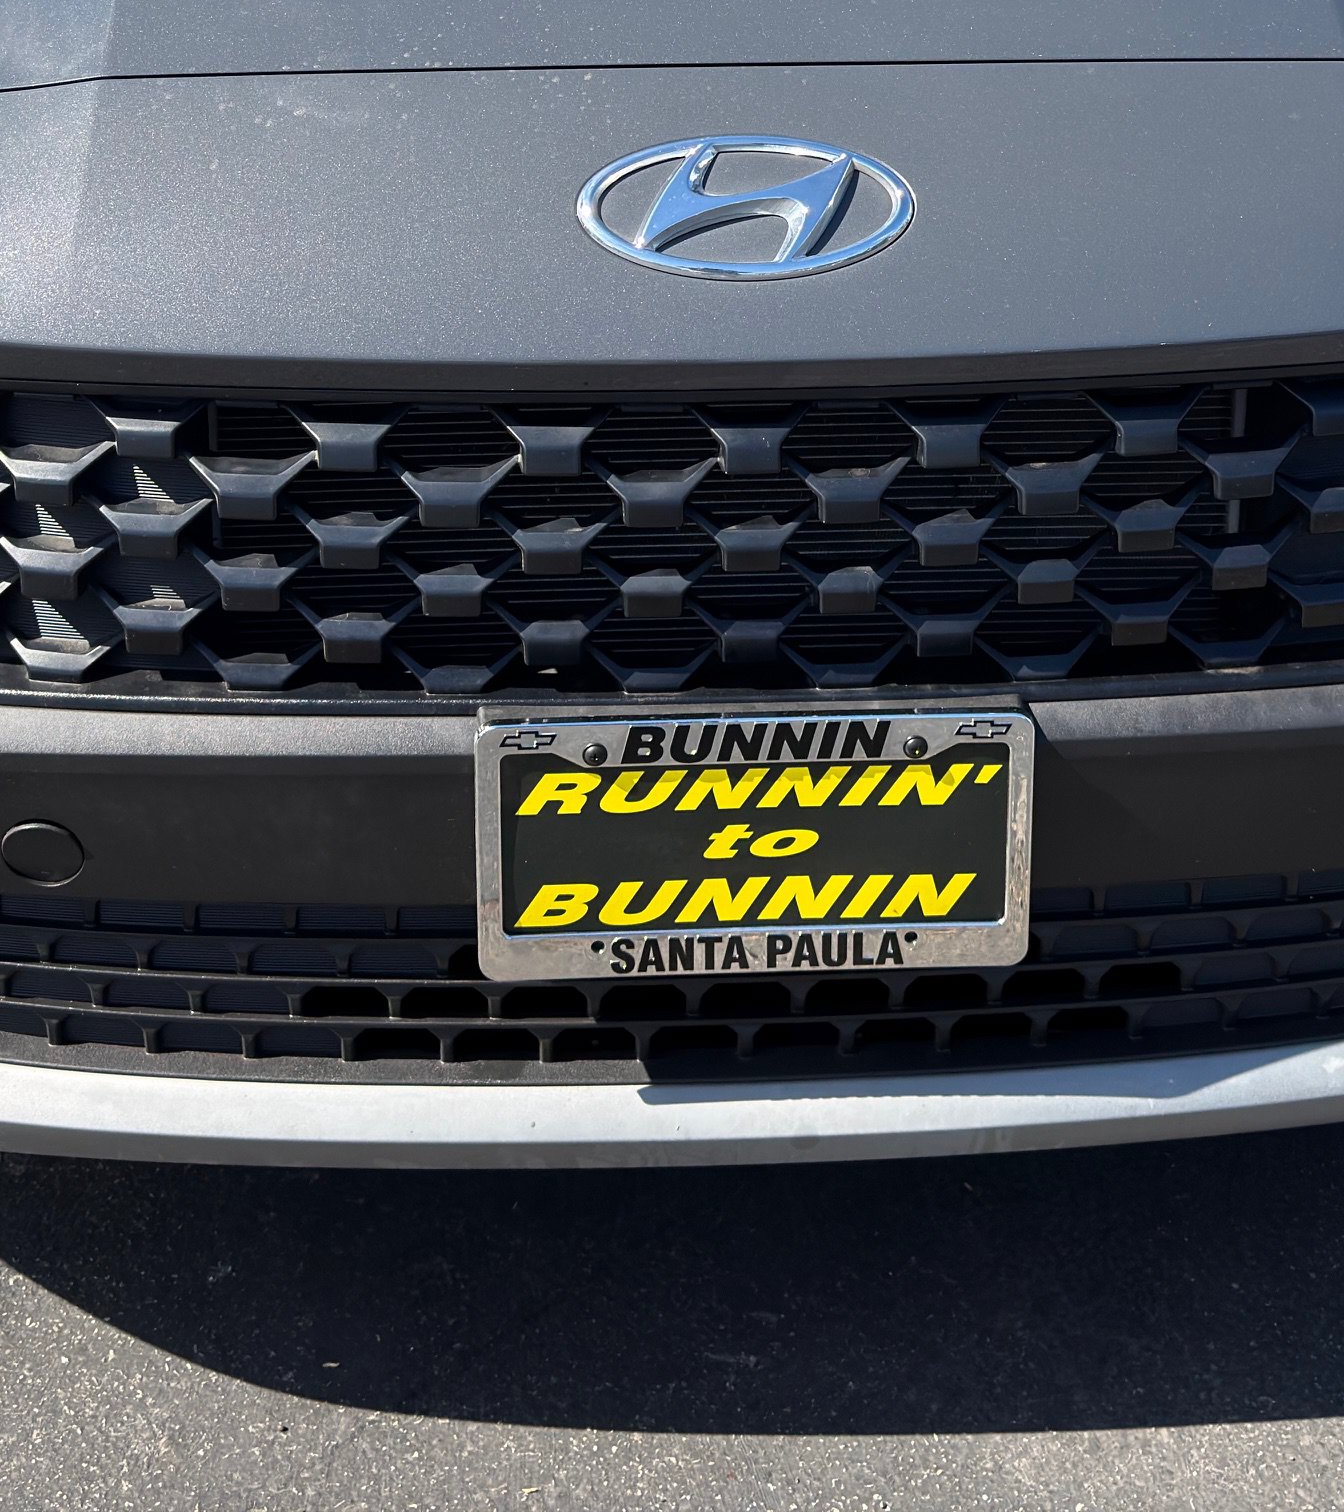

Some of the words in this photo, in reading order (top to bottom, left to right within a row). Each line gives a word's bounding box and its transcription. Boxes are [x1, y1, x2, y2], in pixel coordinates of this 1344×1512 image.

[620, 721, 891, 765] BUNNIN
[515, 763, 1004, 816] RUNNIN'
[702, 824, 820, 859] to
[513, 873, 977, 928] BUNNIN
[609, 935, 750, 975] SANTA
[766, 930, 905, 968] PAULA
